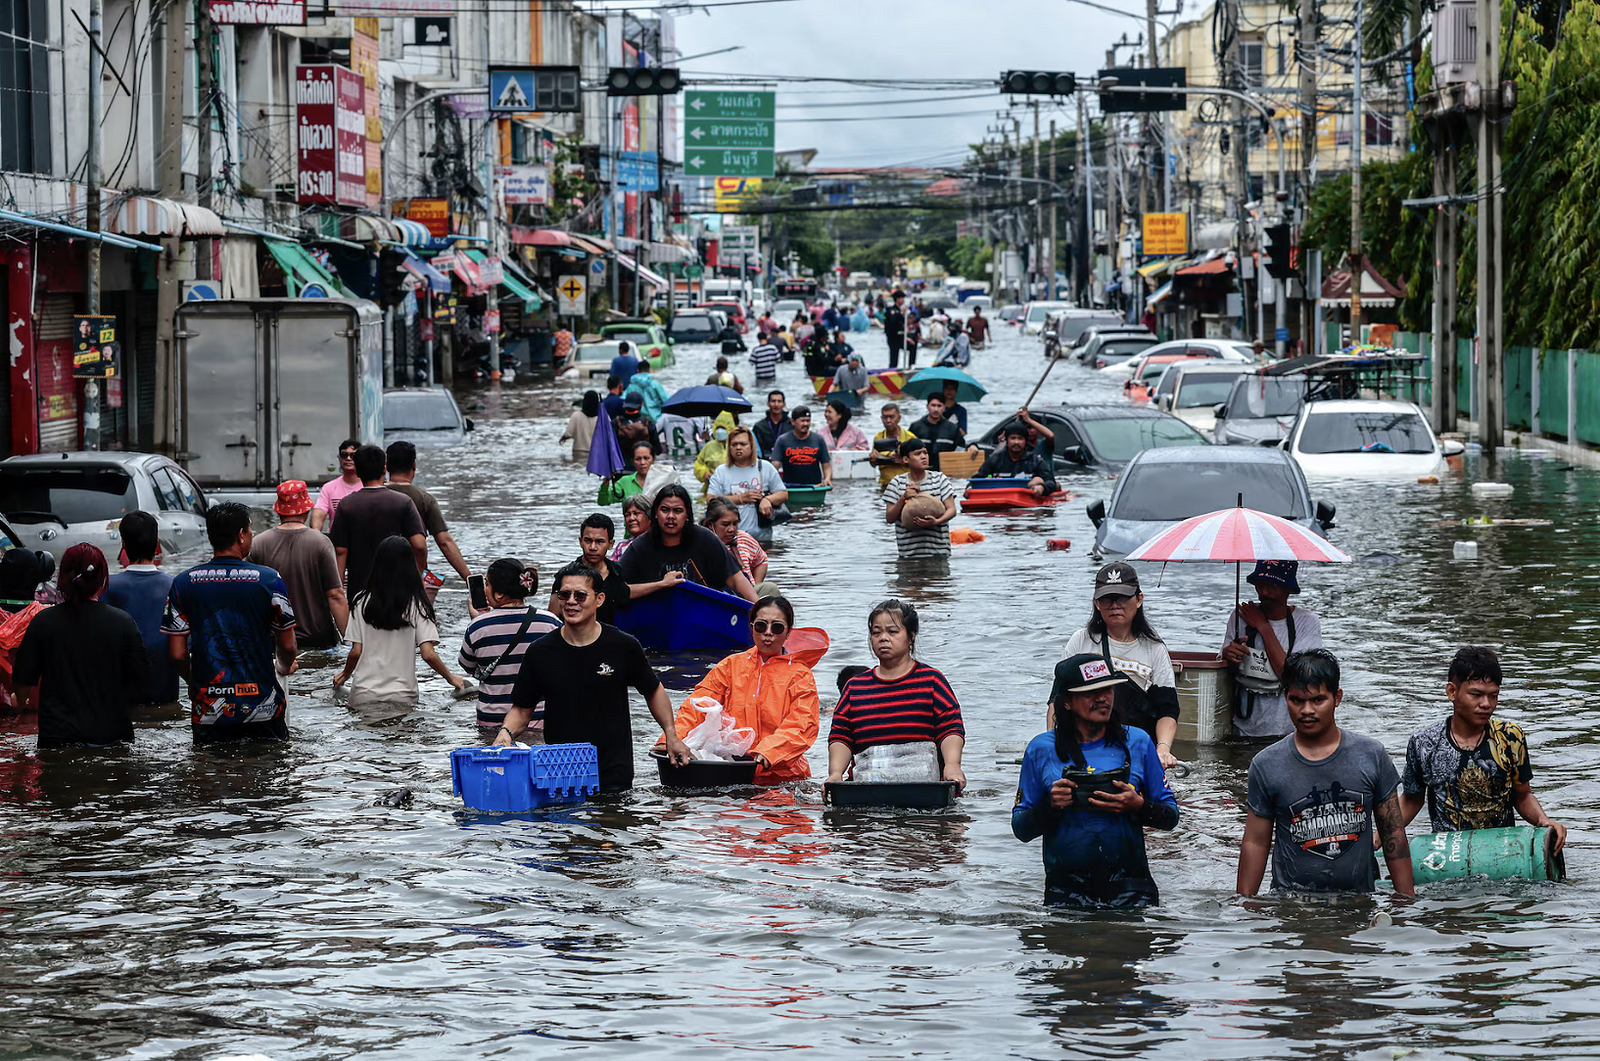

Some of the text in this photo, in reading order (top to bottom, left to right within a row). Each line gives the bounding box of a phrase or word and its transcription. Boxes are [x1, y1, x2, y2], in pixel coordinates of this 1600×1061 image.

[297, 69, 333, 104] เหล็กดัด
[717, 93, 761, 108] ร่มเกล้า
[300, 115, 333, 159] มุ้งลวด
[710, 121, 769, 137] ลาดกระบัง
[723, 150, 758, 168] มีนบุรี
[300, 170, 333, 196] กระจก
[102, 331, 112, 341] 12
[672, 426, 687, 449] 6
[208, 683, 258, 695] Porn hub
